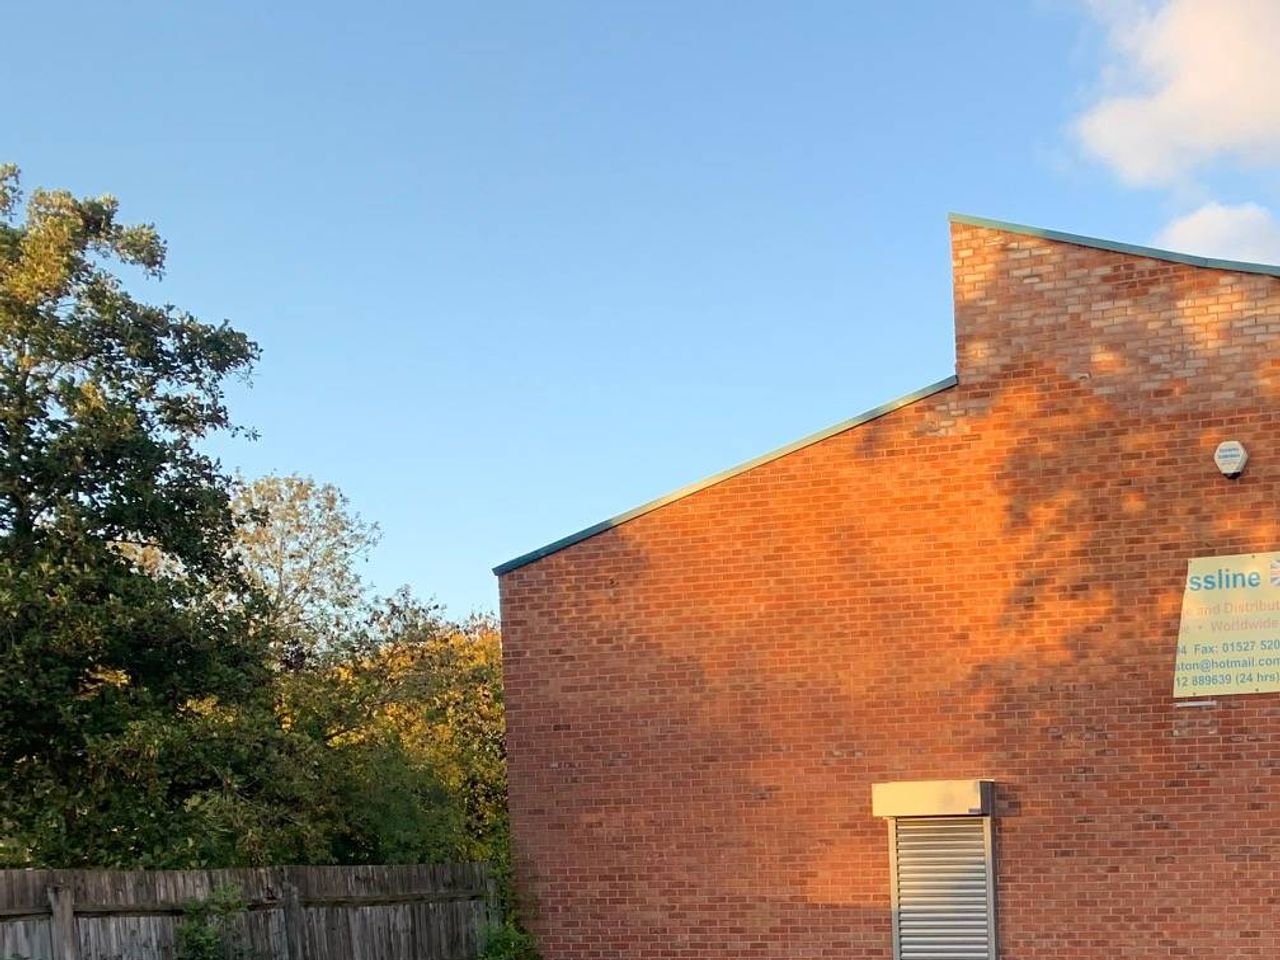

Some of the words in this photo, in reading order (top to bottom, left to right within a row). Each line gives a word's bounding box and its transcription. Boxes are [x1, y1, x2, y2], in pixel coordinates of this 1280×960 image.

[1189, 568, 1261, 591] ssline
[1211, 618, 1280, 632] Worldwide
[1194, 643, 1218, 654] Fax:
[1222, 641, 1255, 653] 01527
[1235, 672, 1253, 686] (24
[1256, 671, 1280, 683] hrs)
